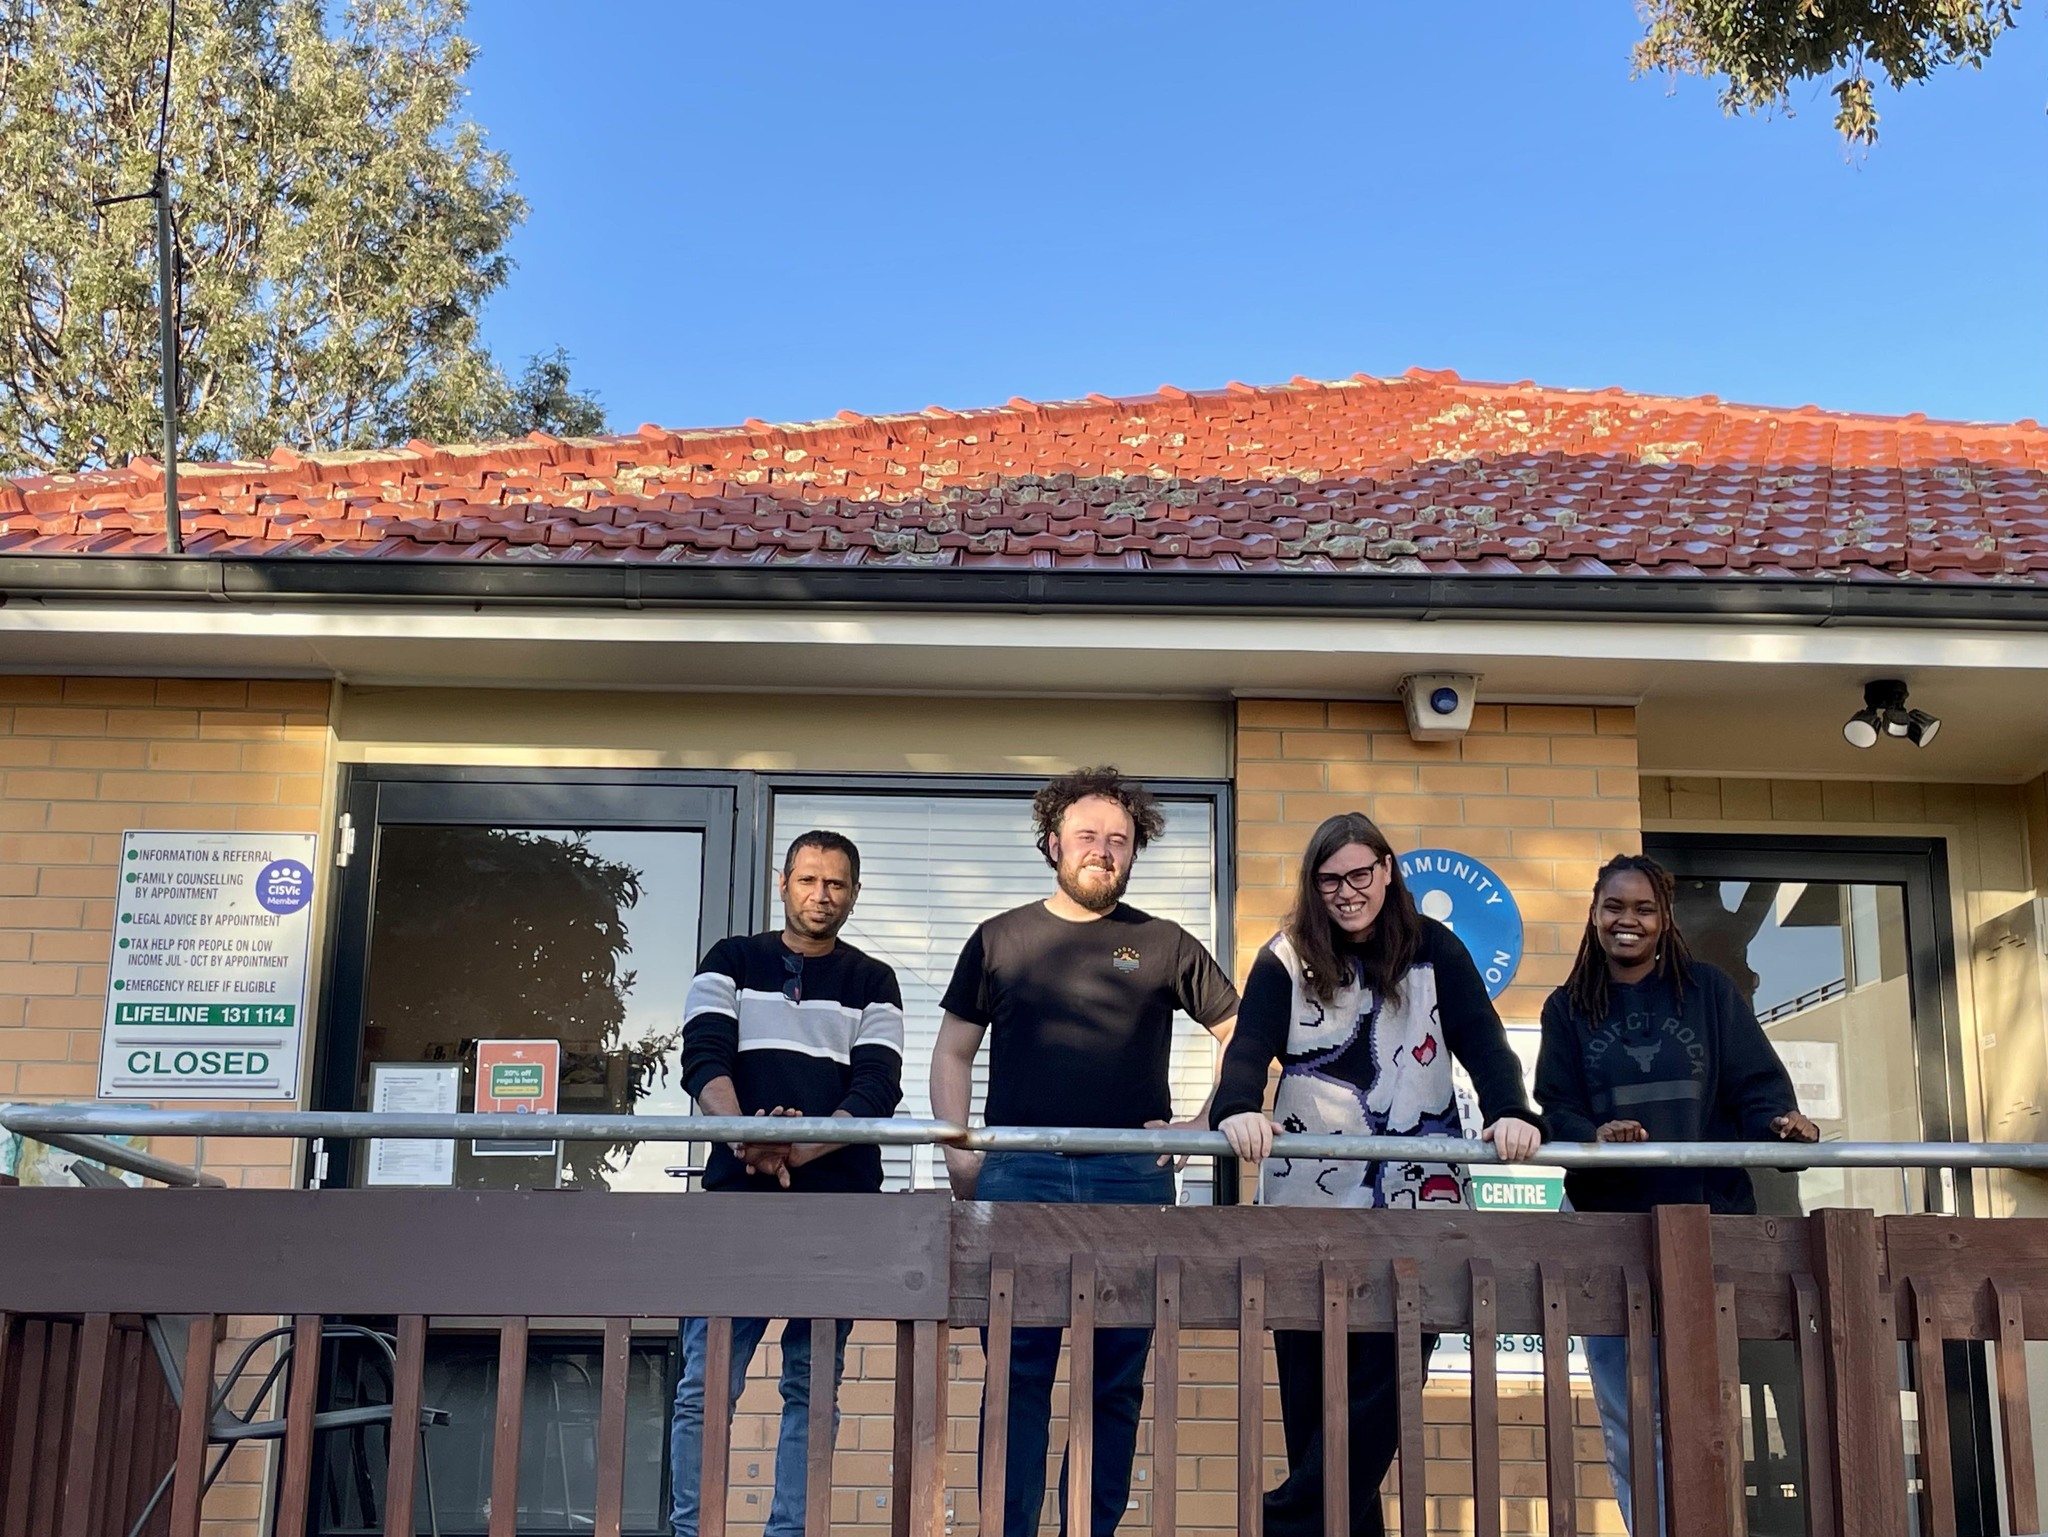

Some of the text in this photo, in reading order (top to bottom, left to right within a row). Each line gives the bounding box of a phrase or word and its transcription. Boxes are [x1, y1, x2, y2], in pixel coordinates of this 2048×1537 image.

[139, 849, 274, 862] INFORMATION & REFERRAL
[136, 872, 243, 885] FAMILY COUNSELLING
[1400, 856, 1503, 905] MMUNITY
[135, 887, 219, 900] BY APPOINTMENT
[268, 885, 301, 896] CISVic
[267, 897, 300, 906] Member
[132, 913, 281, 926] LEGAL ADVICE BY APPOINTMENT
[131, 939, 273, 951] TAX HELP FOR PEOPLE ON LOW
[128, 954, 163, 966] INCOME
[165, 955, 182, 966] JUL
[190, 955, 208, 966] OCT
[210, 955, 223, 967] BY
[225, 956, 289, 968] APPOINTMENT
[125, 979, 276, 993] EMERGENCY RELIEF IF ELIGIBLE
[122, 1006, 286, 1023] LIFELINE 131 114
[1585, 1012, 1705, 1086] ROJECT ROCK
[127, 1051, 269, 1075] CLOSED
[1481, 1182, 1547, 1205] CENTRE
